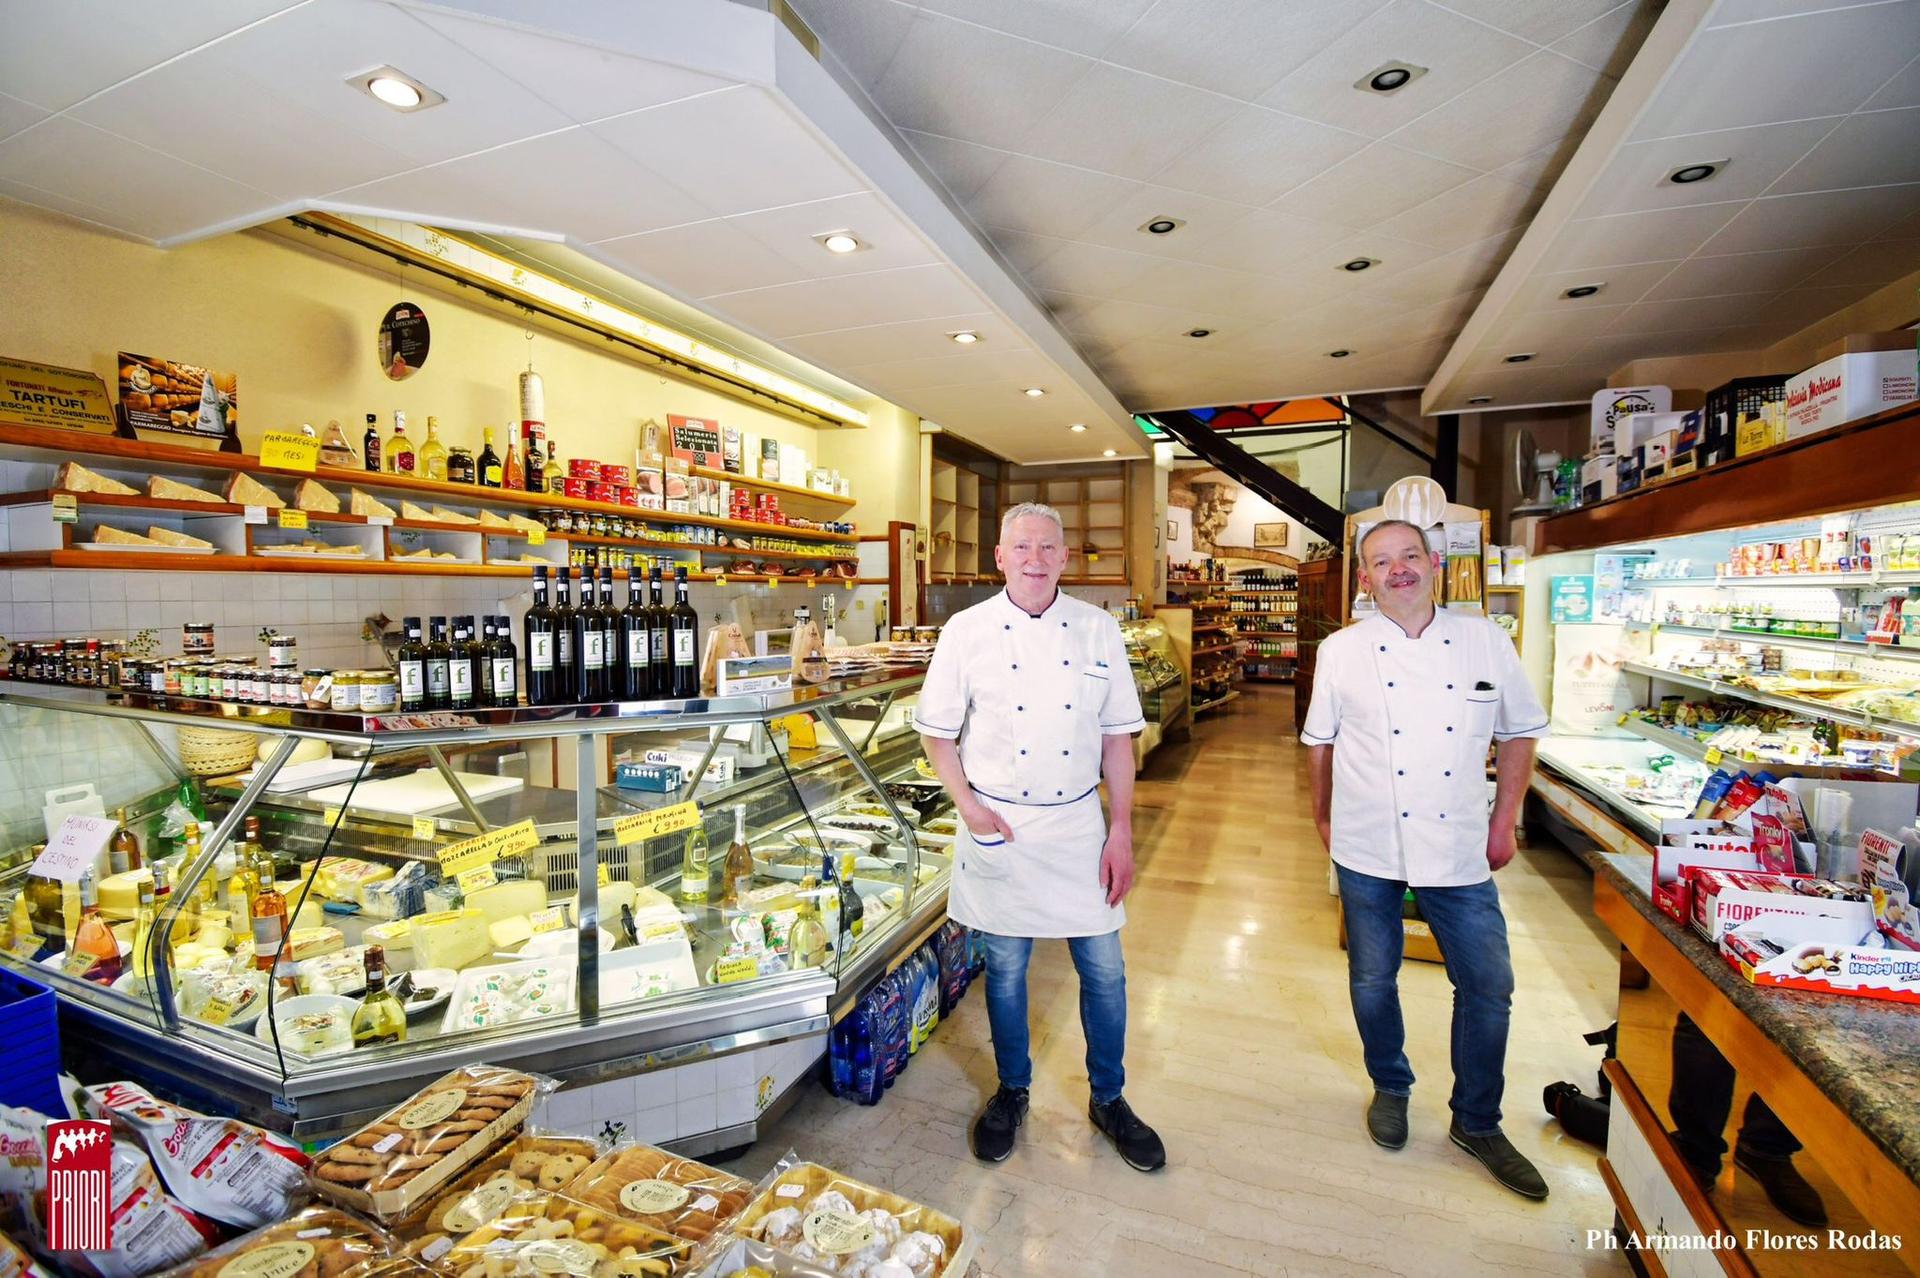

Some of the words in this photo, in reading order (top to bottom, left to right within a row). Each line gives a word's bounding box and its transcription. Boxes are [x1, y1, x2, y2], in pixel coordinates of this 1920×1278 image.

[9, 389, 86, 410] TARTUFI
[51, 408, 110, 422] CONSERVATI
[1613, 403, 1649, 416] Pausa
[674, 427, 717, 439] Salumeria
[675, 435, 718, 446] Selezionata
[406, 667, 417, 686] f
[432, 665, 444, 683] f
[455, 666, 467, 684] f
[500, 664, 510, 682] f
[647, 752, 669, 763] Cuki
[1759, 821, 1783, 839] Tronky
[1850, 952, 1879, 962] kinder
[1849, 962, 1893, 976] Happy
[1893, 961, 1920, 975] Hip
